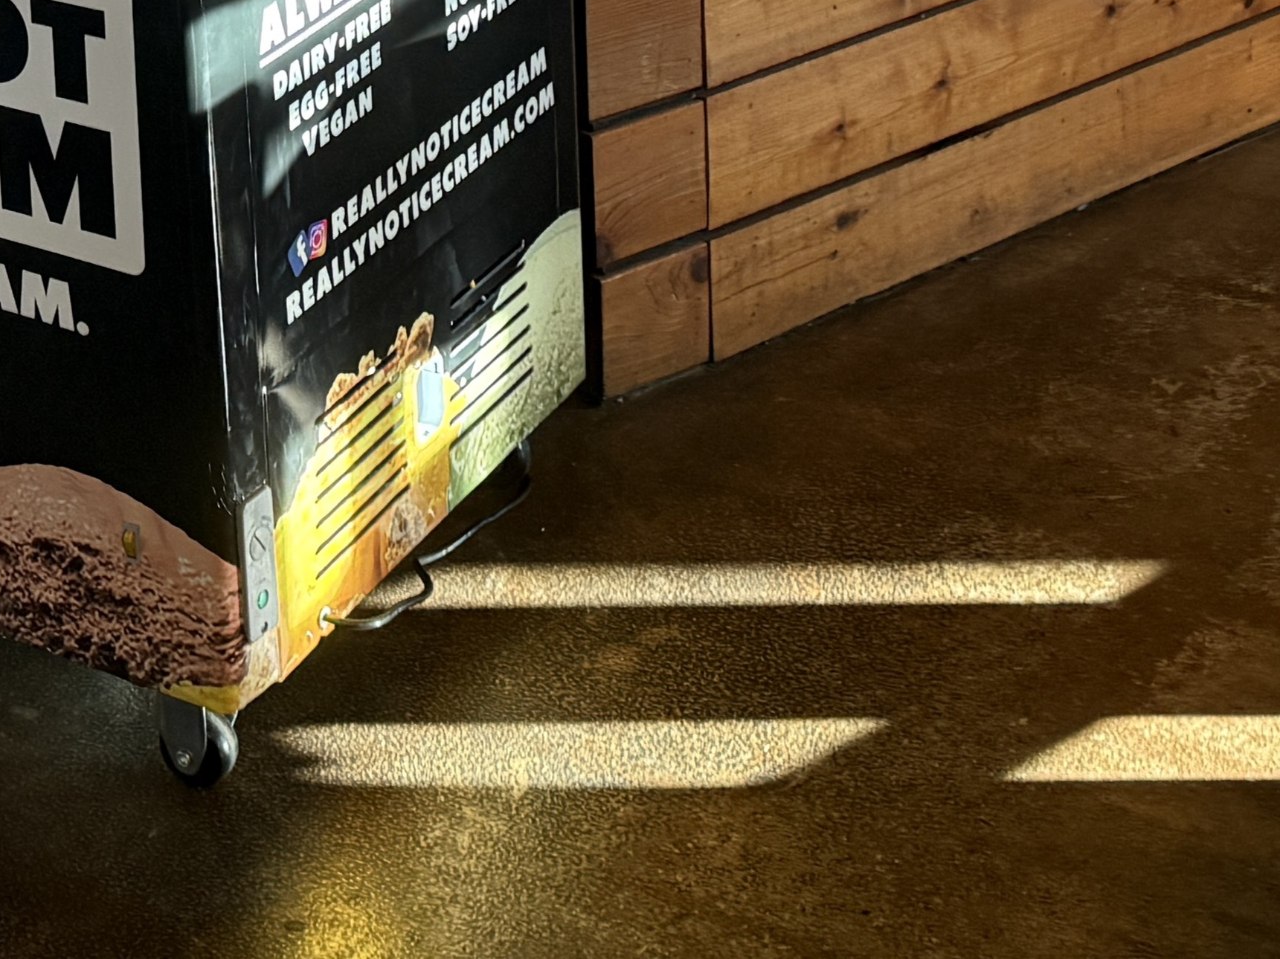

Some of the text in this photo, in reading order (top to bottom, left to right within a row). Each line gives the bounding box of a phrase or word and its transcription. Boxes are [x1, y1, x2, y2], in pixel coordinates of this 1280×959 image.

[288, 41, 382, 132] EGG-FREE
[302, 85, 373, 157] VEGAN
[331, 46, 548, 240] REALLYNOTICECREAM
[285, 81, 555, 326] REALLYNOTICECREAM.COM
